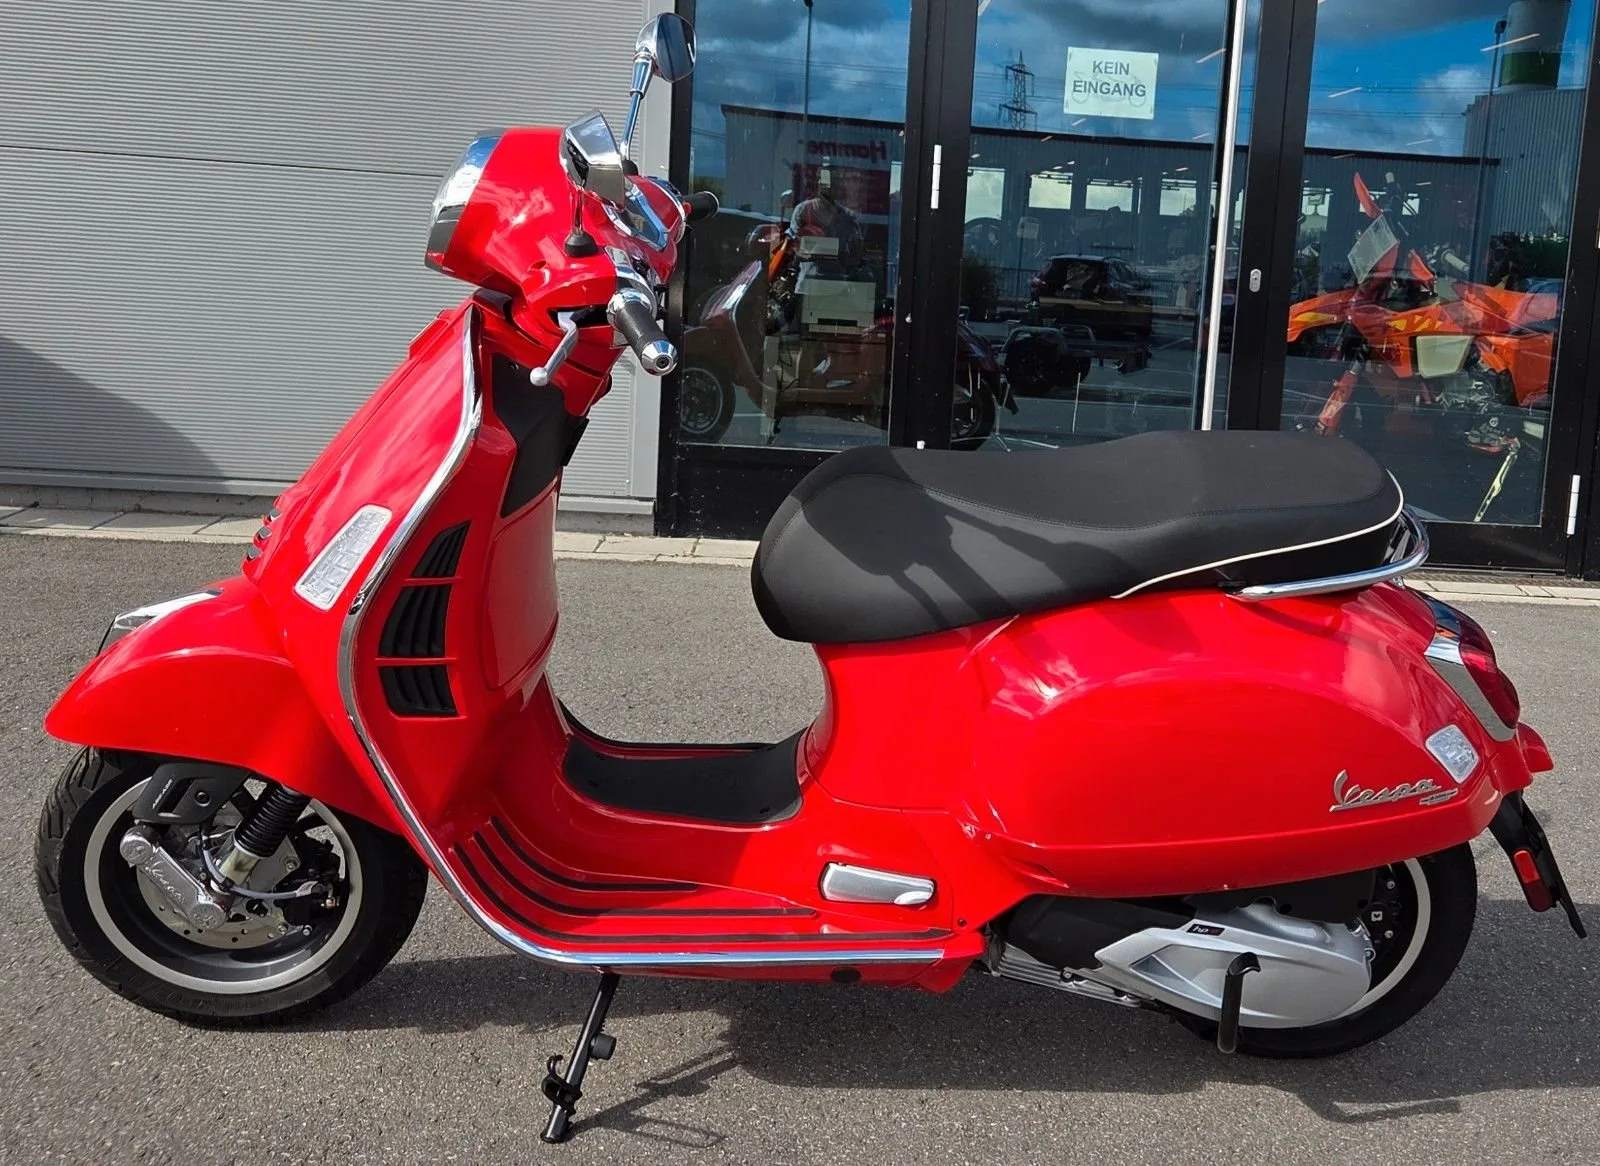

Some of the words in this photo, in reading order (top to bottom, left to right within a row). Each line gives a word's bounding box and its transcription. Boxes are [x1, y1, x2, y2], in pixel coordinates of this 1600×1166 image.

[1092, 60, 1130, 75] KEIN
[1072, 79, 1147, 97] EINGANG
[1328, 769, 1442, 812] Vespa
